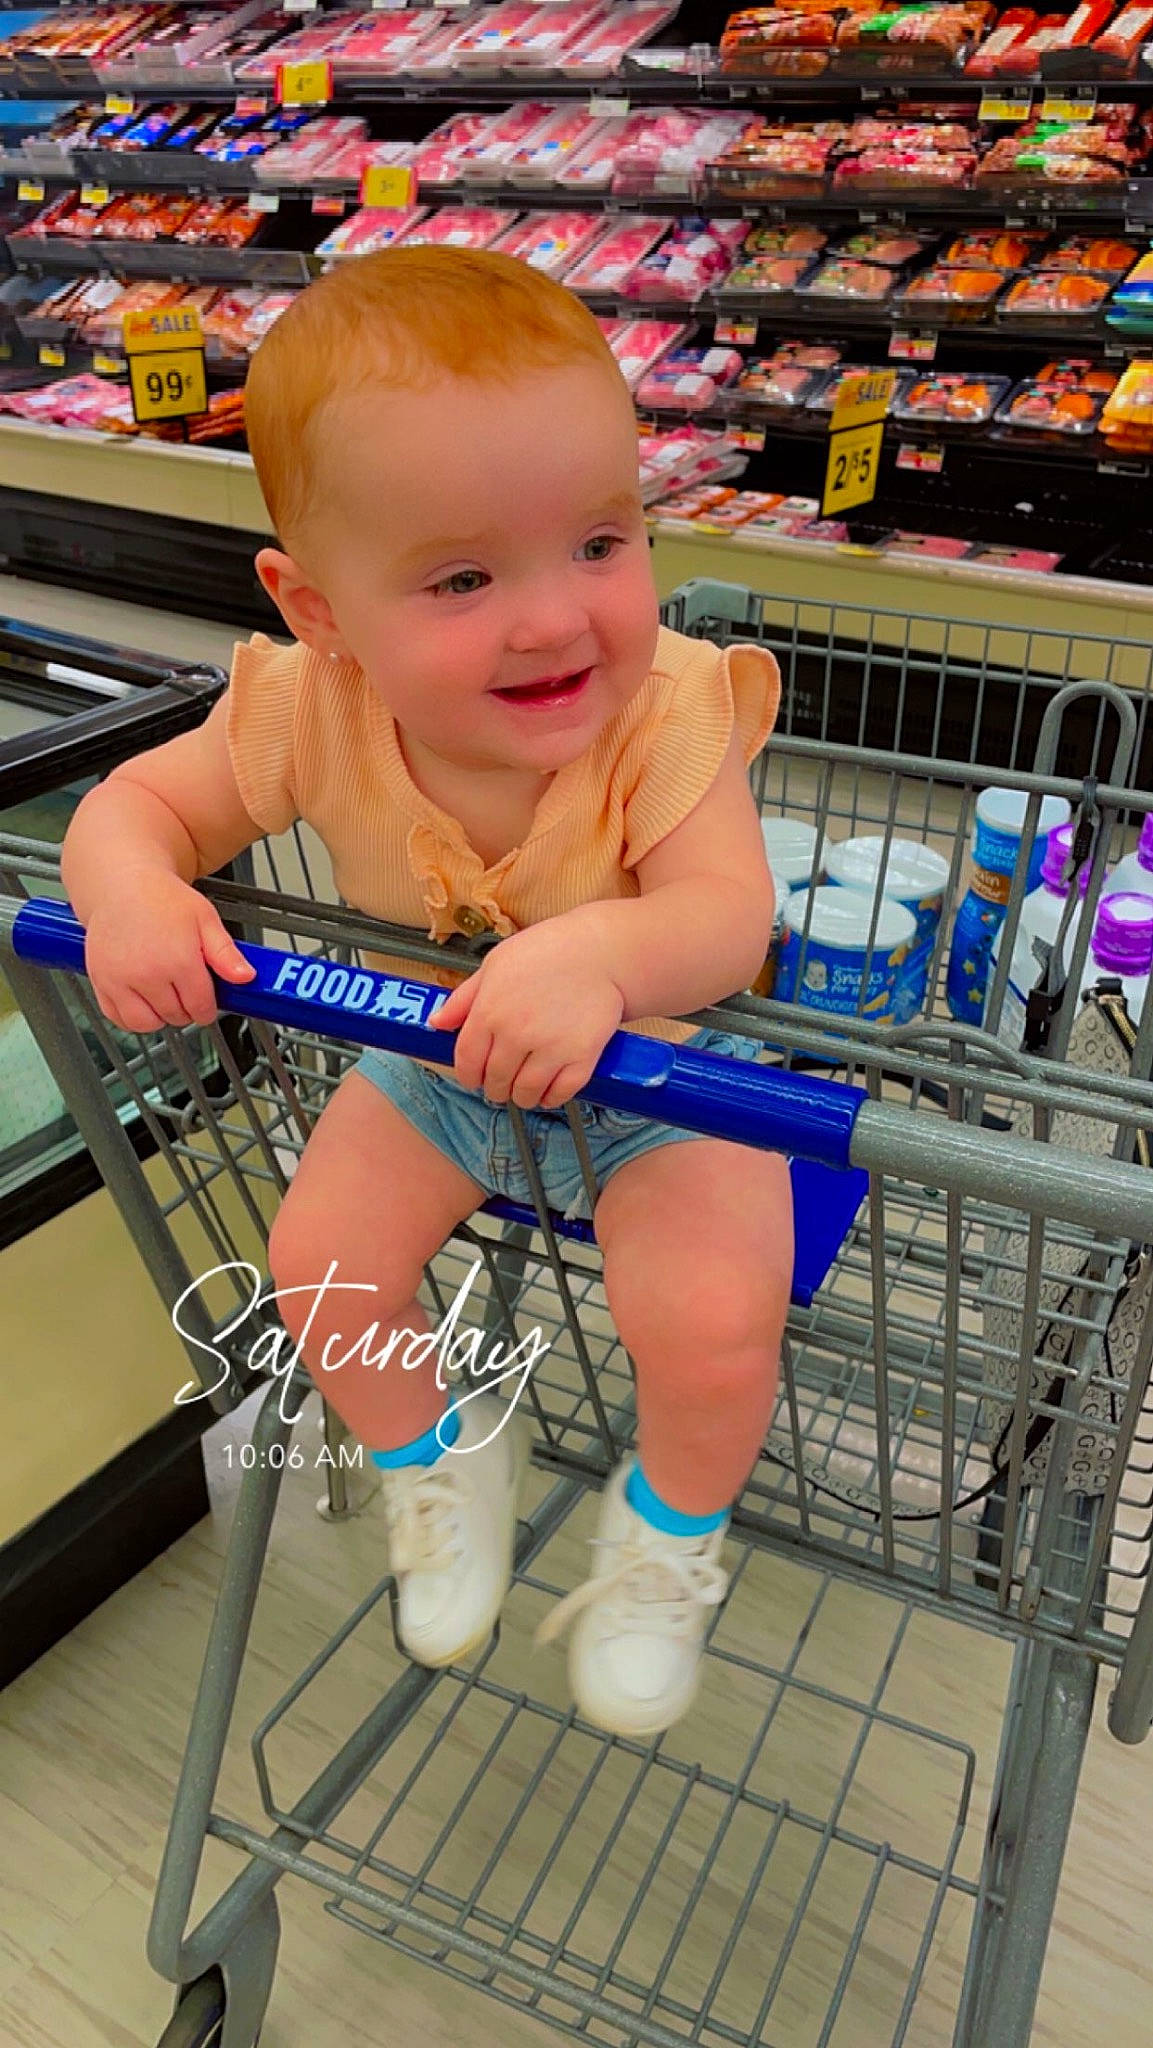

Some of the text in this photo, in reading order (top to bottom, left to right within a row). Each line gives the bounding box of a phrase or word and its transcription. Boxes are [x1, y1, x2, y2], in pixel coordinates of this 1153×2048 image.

[150, 315, 191, 334] SALE
[857, 378, 889, 404] SALE
[273, 958, 374, 1011] FOOD
